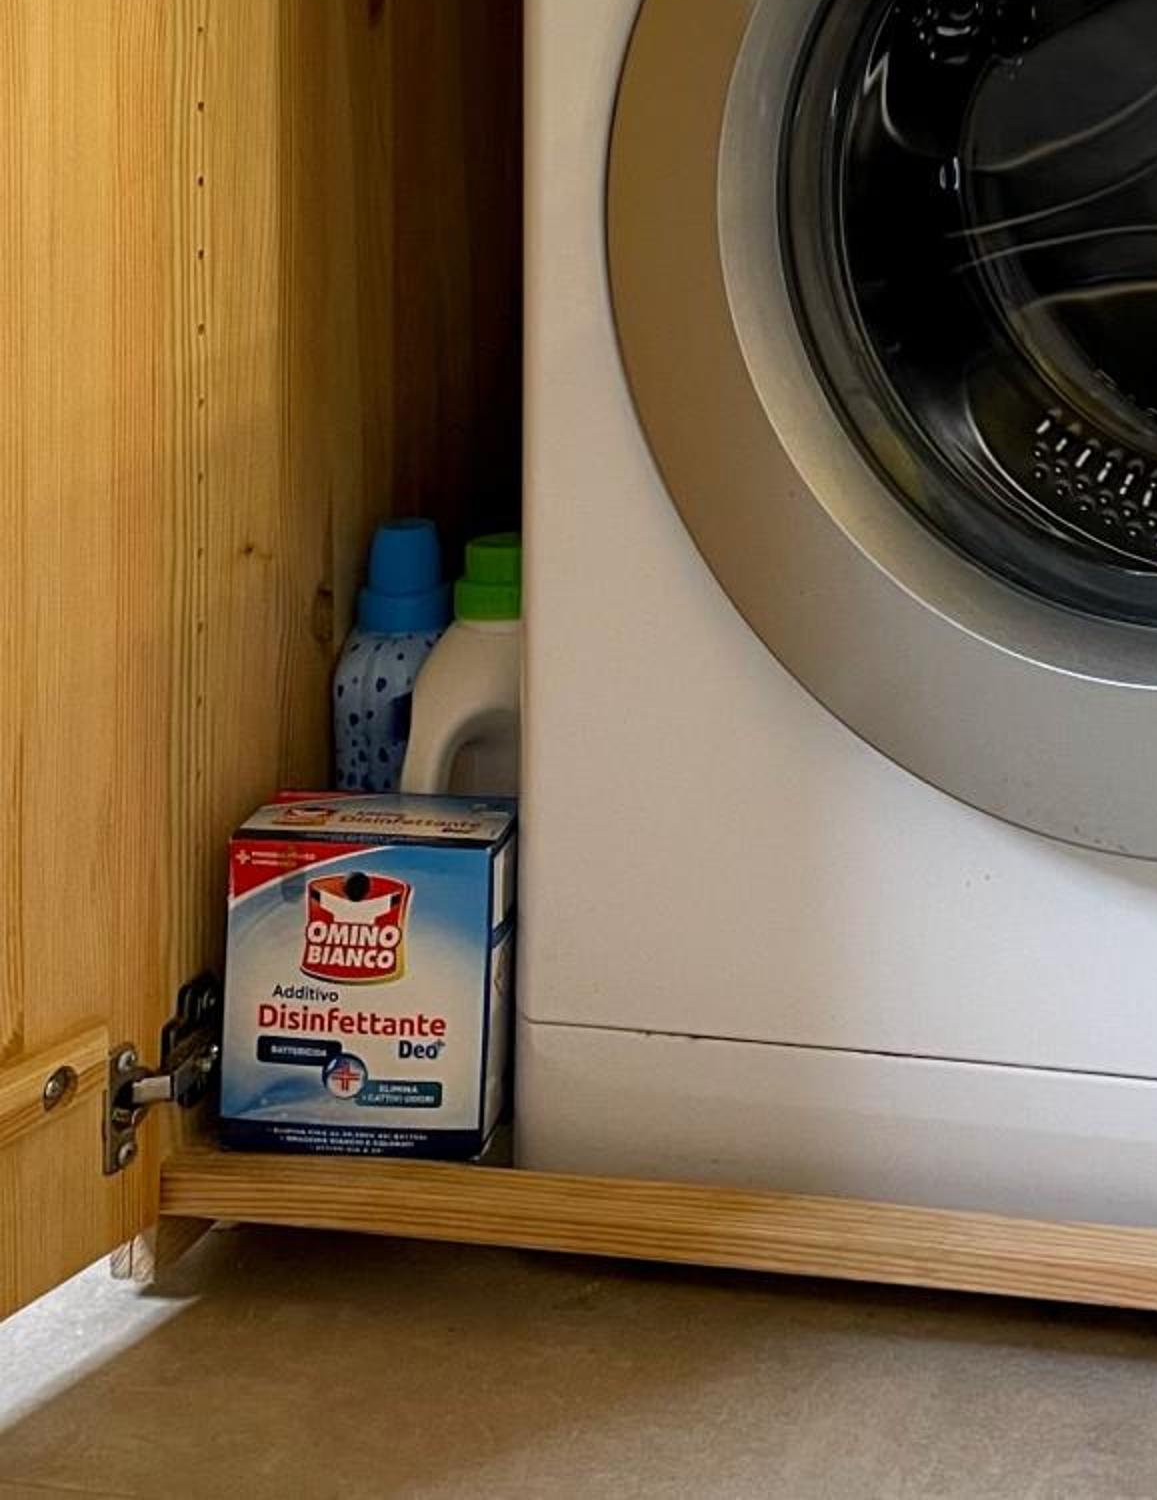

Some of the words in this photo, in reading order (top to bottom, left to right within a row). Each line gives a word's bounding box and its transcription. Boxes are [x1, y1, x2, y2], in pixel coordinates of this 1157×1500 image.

[308, 921, 400, 949] OMINO
[307, 945, 395, 969] BIANCO
[272, 985, 339, 1003] Additivo
[258, 1004, 446, 1037] Disinfettante
